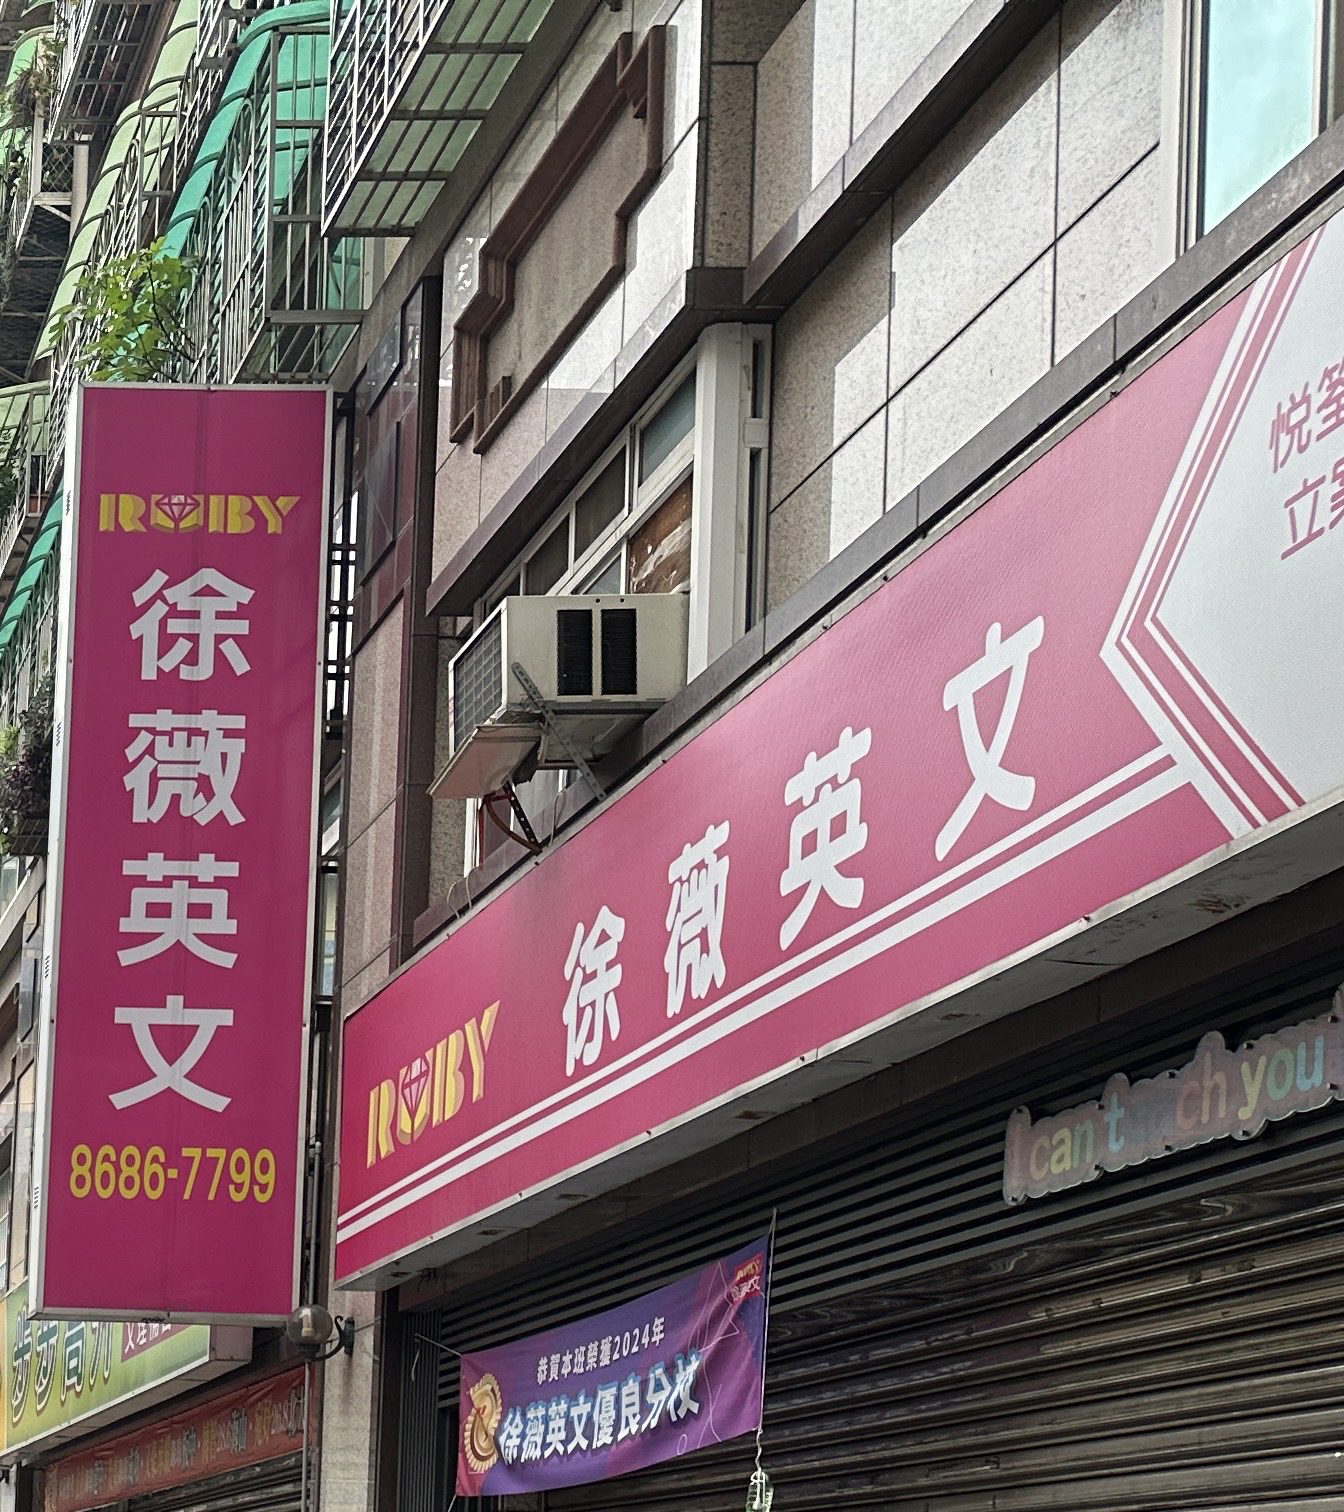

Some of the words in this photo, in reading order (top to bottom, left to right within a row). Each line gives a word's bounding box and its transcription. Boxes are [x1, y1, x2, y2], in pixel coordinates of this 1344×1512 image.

[98, 493, 300, 535] RUBY
[109, 567, 255, 1113] 徐薇英文
[562, 615, 1044, 1077] 徐薇英文
[366, 1000, 501, 1169] RUBY
[1029, 1120, 1095, 1181] can
[1103, 1052, 1227, 1153] tch
[1237, 1034, 1325, 1121] you
[69, 1143, 276, 1203] 8686-7799
